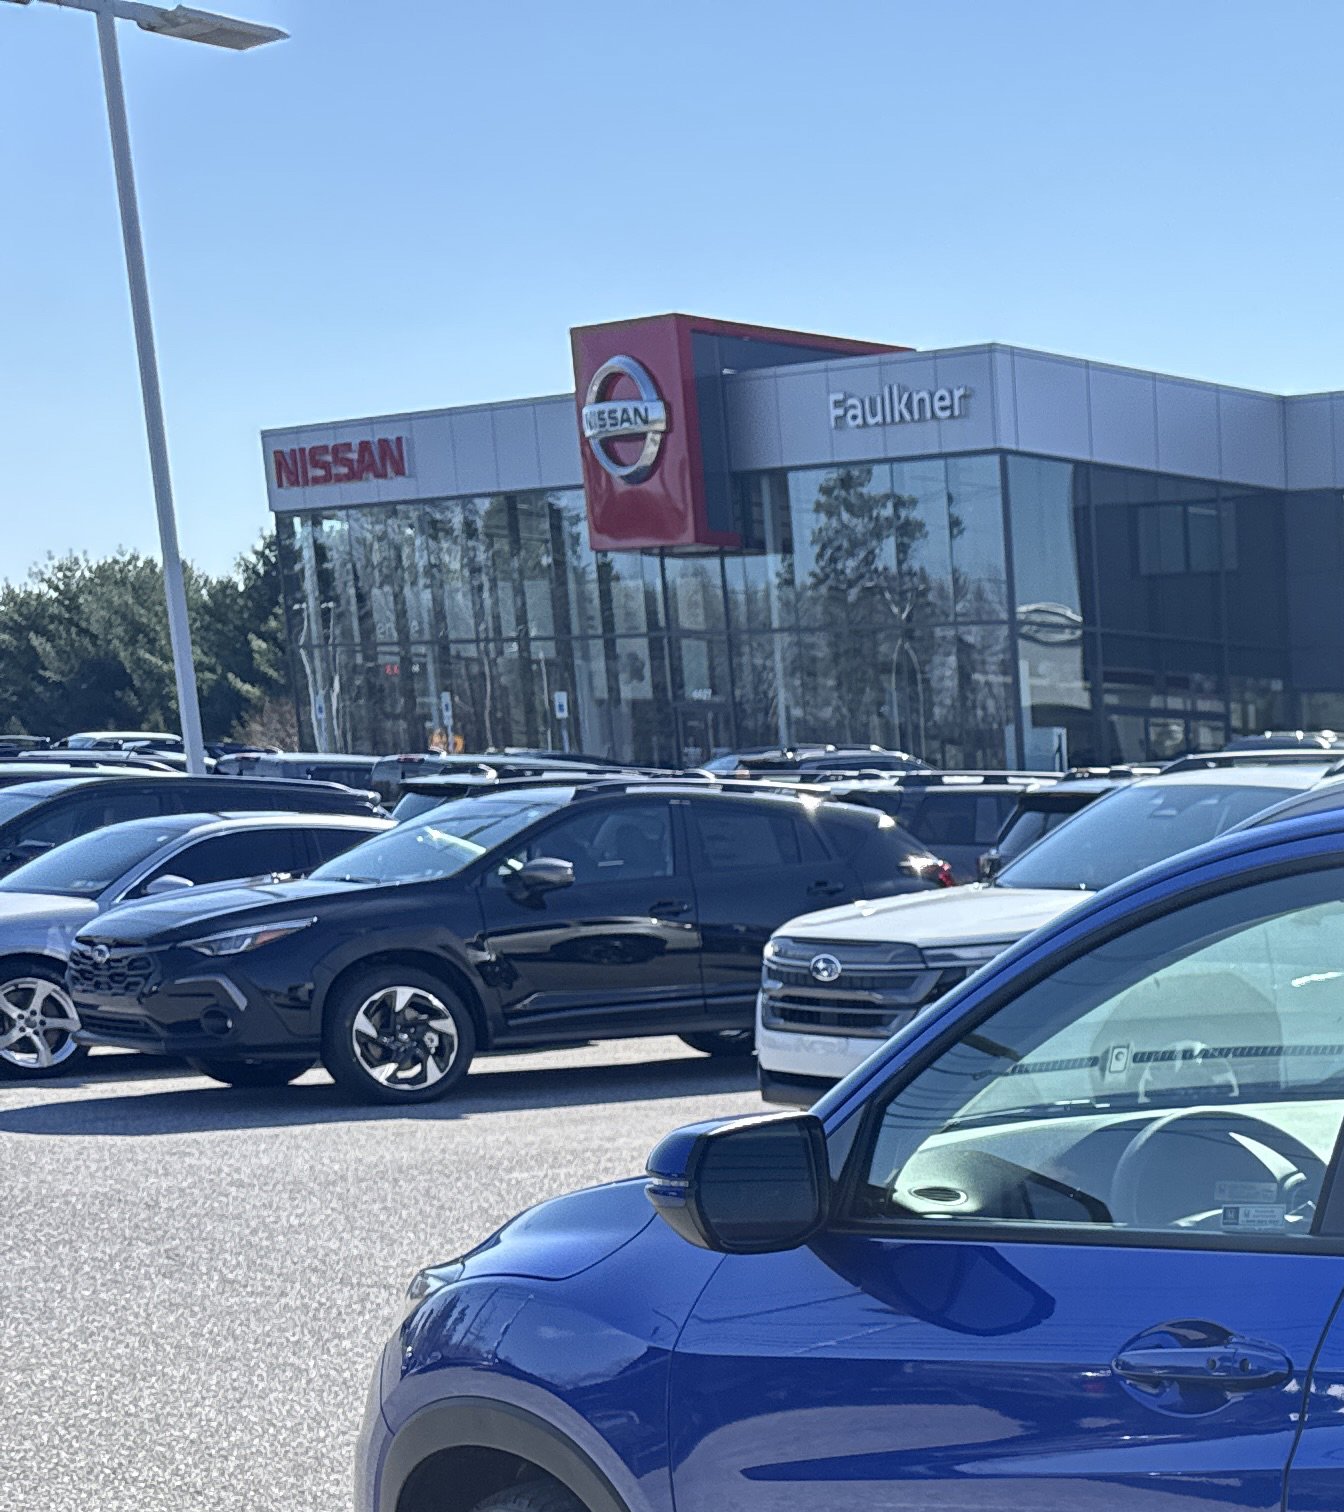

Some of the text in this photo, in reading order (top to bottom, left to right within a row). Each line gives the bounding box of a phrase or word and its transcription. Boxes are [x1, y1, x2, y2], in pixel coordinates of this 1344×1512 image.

[584, 406, 649, 431] NISSAN
[829, 383, 967, 429] Faulkner
[273, 436, 406, 488] NISSAN
